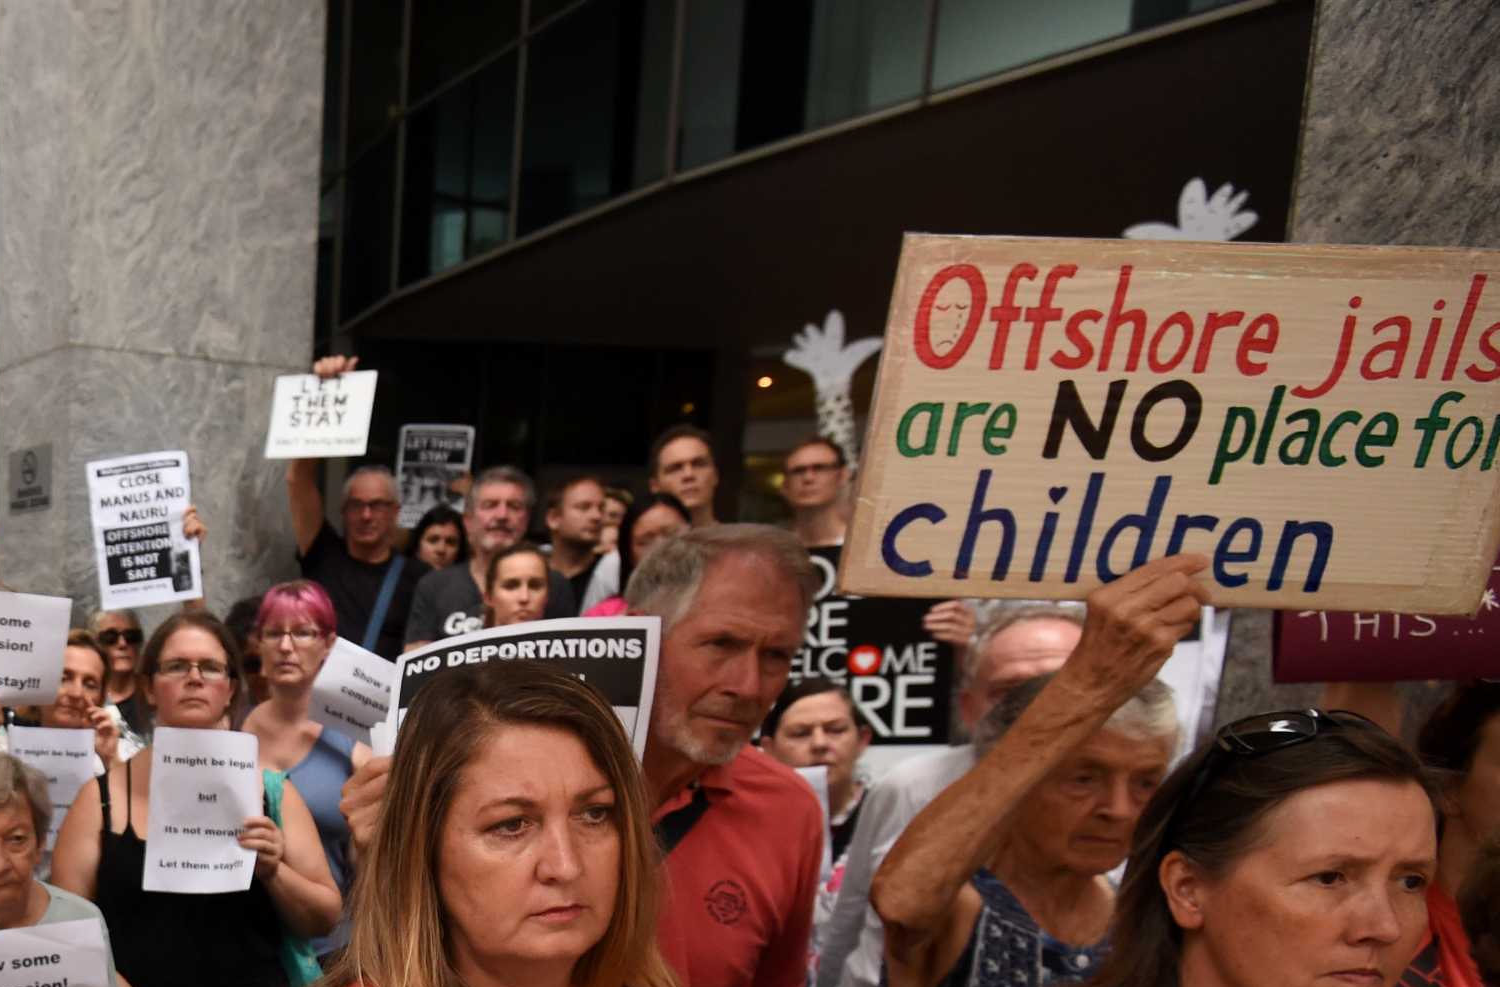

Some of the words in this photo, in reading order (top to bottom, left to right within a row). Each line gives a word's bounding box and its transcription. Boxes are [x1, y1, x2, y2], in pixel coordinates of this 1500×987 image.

[913, 261, 1281, 376] Offshore
[1290, 274, 1500, 399] jails
[301, 375, 345, 394] LET
[292, 394, 349, 409] THEM
[289, 411, 347, 428] STAY
[896, 400, 1018, 458] are
[1042, 379, 1203, 463] NO
[1207, 384, 1398, 485] place
[119, 473, 161, 489] CLOSE
[100, 491, 150, 508] MANUS
[156, 486, 185, 500] AND
[120, 506, 169, 522] NAURU
[106, 524, 169, 542] OFFSHORE
[881, 469, 1334, 593] children
[106, 537, 174, 556] DETENTION
[121, 556, 133, 568] IS
[136, 553, 160, 566] NOT
[127, 566, 157, 581] SAFE
[406, 656, 441, 676] NO
[447, 638, 643, 668] DEPORTATIONS
[163, 754, 172, 764] It
[175, 755, 208, 768] might
[211, 757, 226, 767] be
[229, 759, 255, 771] legal
[198, 791, 218, 803] but
[164, 825, 179, 835] Its
[183, 826, 202, 836] not
[159, 859, 178, 869] Let
[181, 860, 211, 871] them
[213, 860, 244, 872] stay!!!
[11, 953, 62, 970] some
